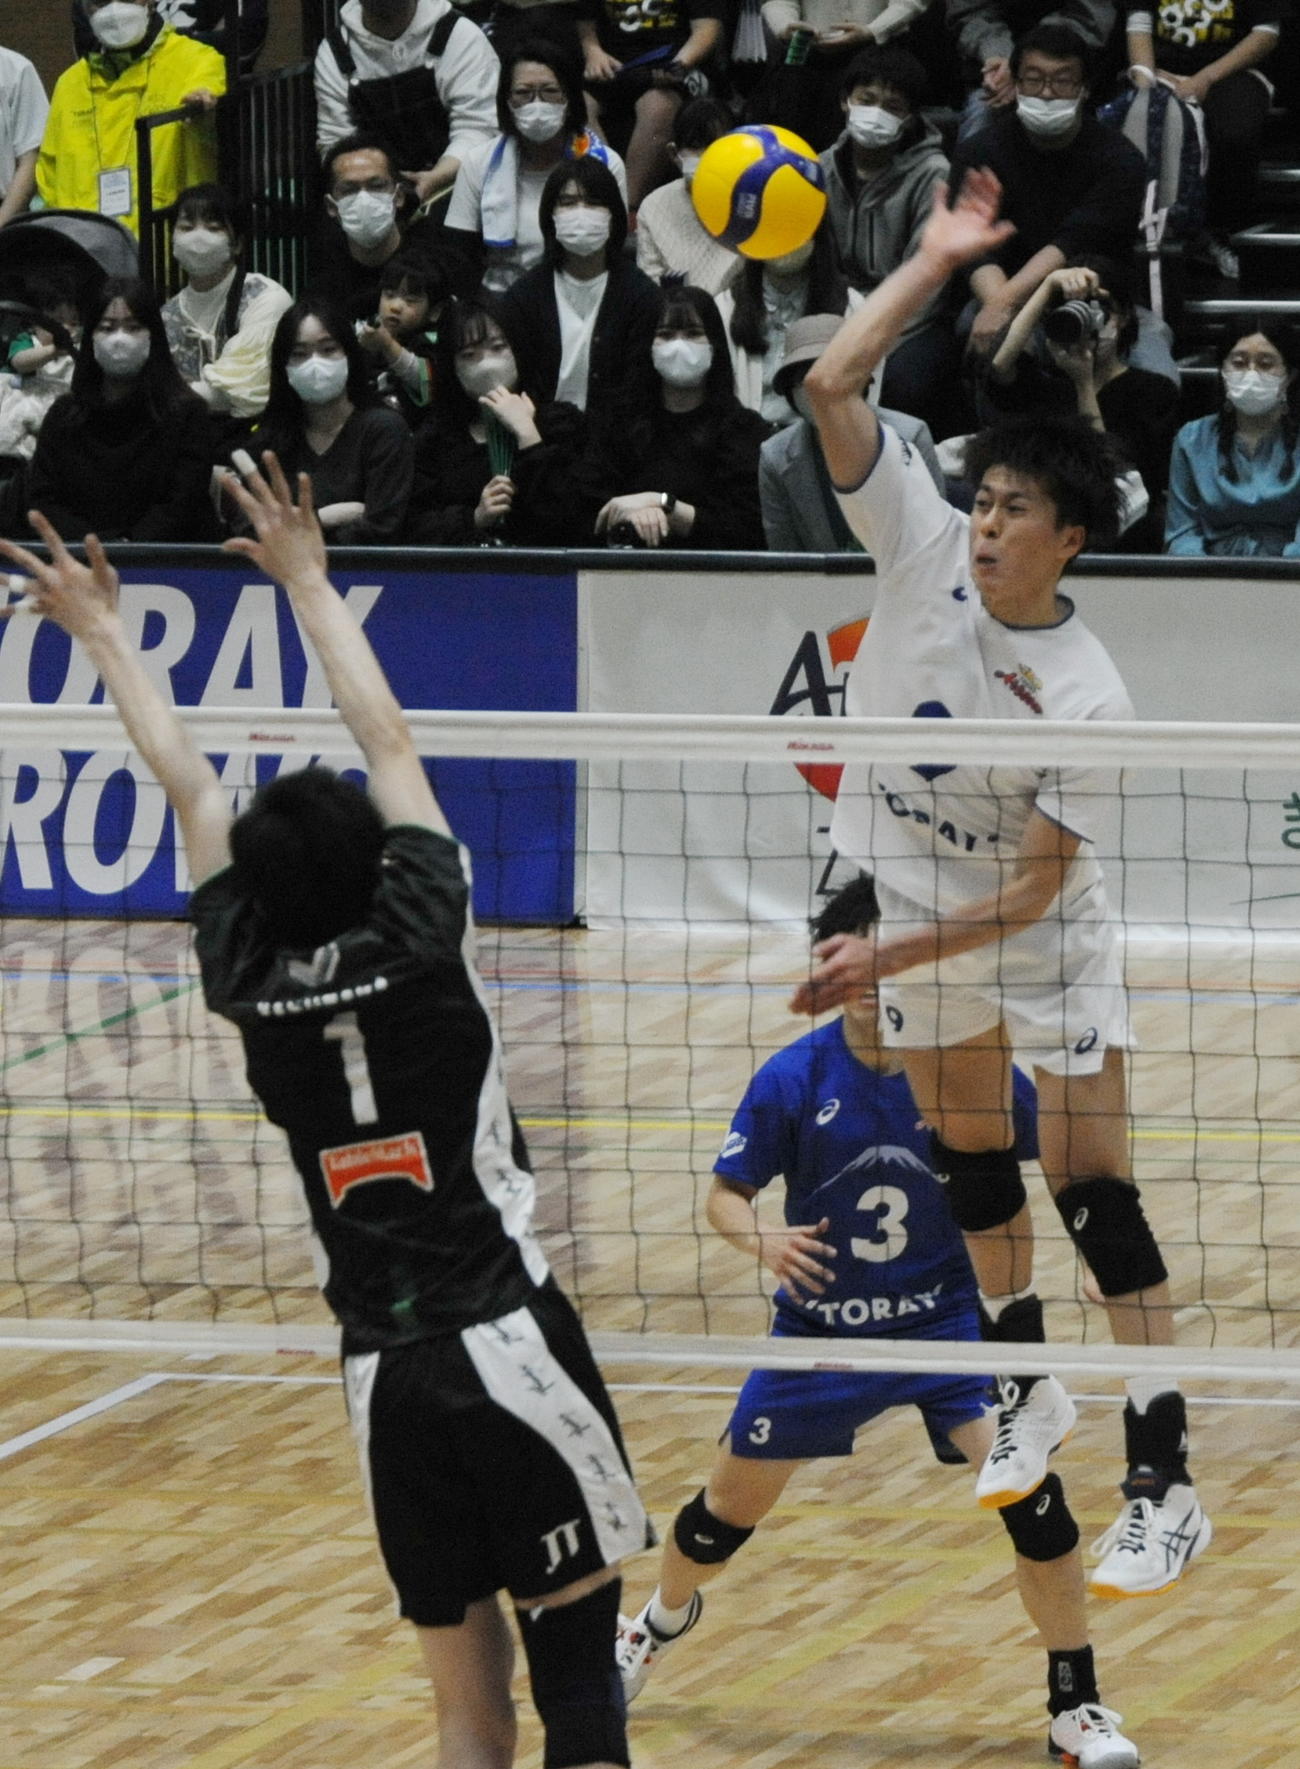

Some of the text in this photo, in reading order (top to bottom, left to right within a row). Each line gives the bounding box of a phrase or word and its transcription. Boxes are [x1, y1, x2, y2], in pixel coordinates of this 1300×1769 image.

[323, 1010, 379, 1124] 1
[850, 1185, 909, 1263] 3
[816, 1290, 937, 1326] TORAY
[748, 1416, 772, 1445] 3
[540, 1519, 581, 1575] JT
